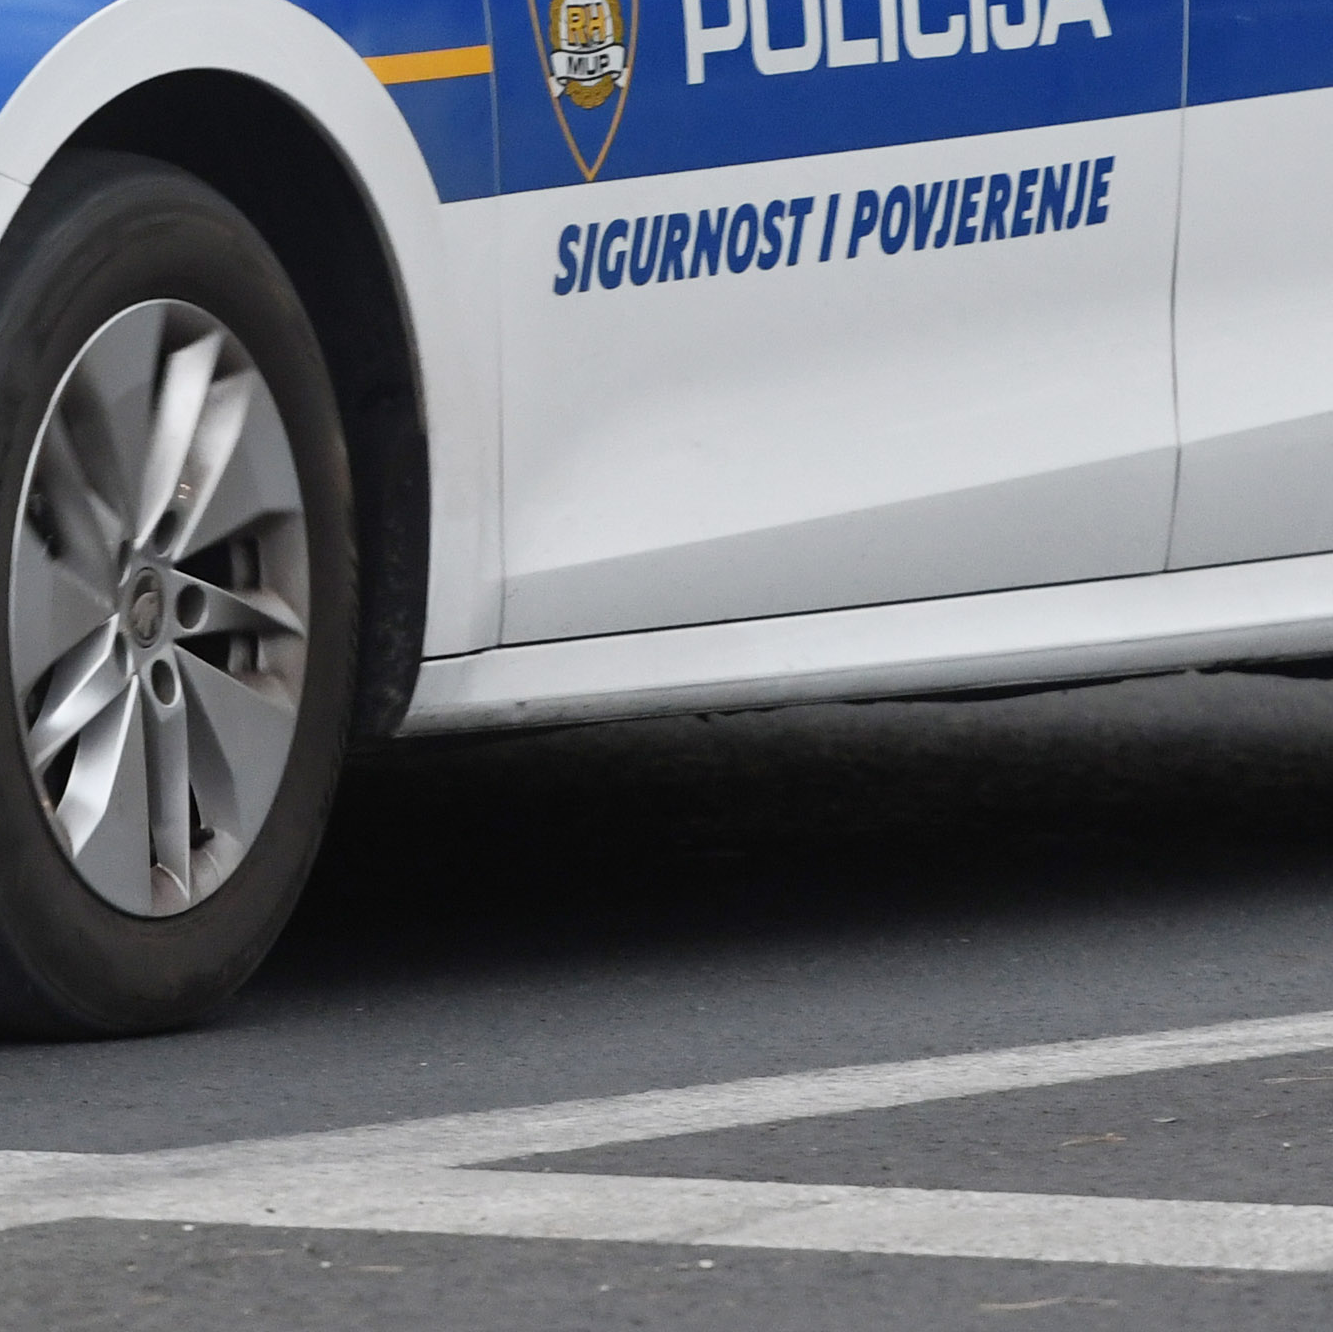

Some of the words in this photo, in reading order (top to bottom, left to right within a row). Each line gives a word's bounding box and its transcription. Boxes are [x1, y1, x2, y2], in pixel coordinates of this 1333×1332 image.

[566, 2, 607, 47] RH
[567, 53, 611, 75] MUP
[552, 196, 815, 296] SIGURNOST
[818, 194, 842, 262] I
[846, 155, 1117, 259] POVJERENJE
